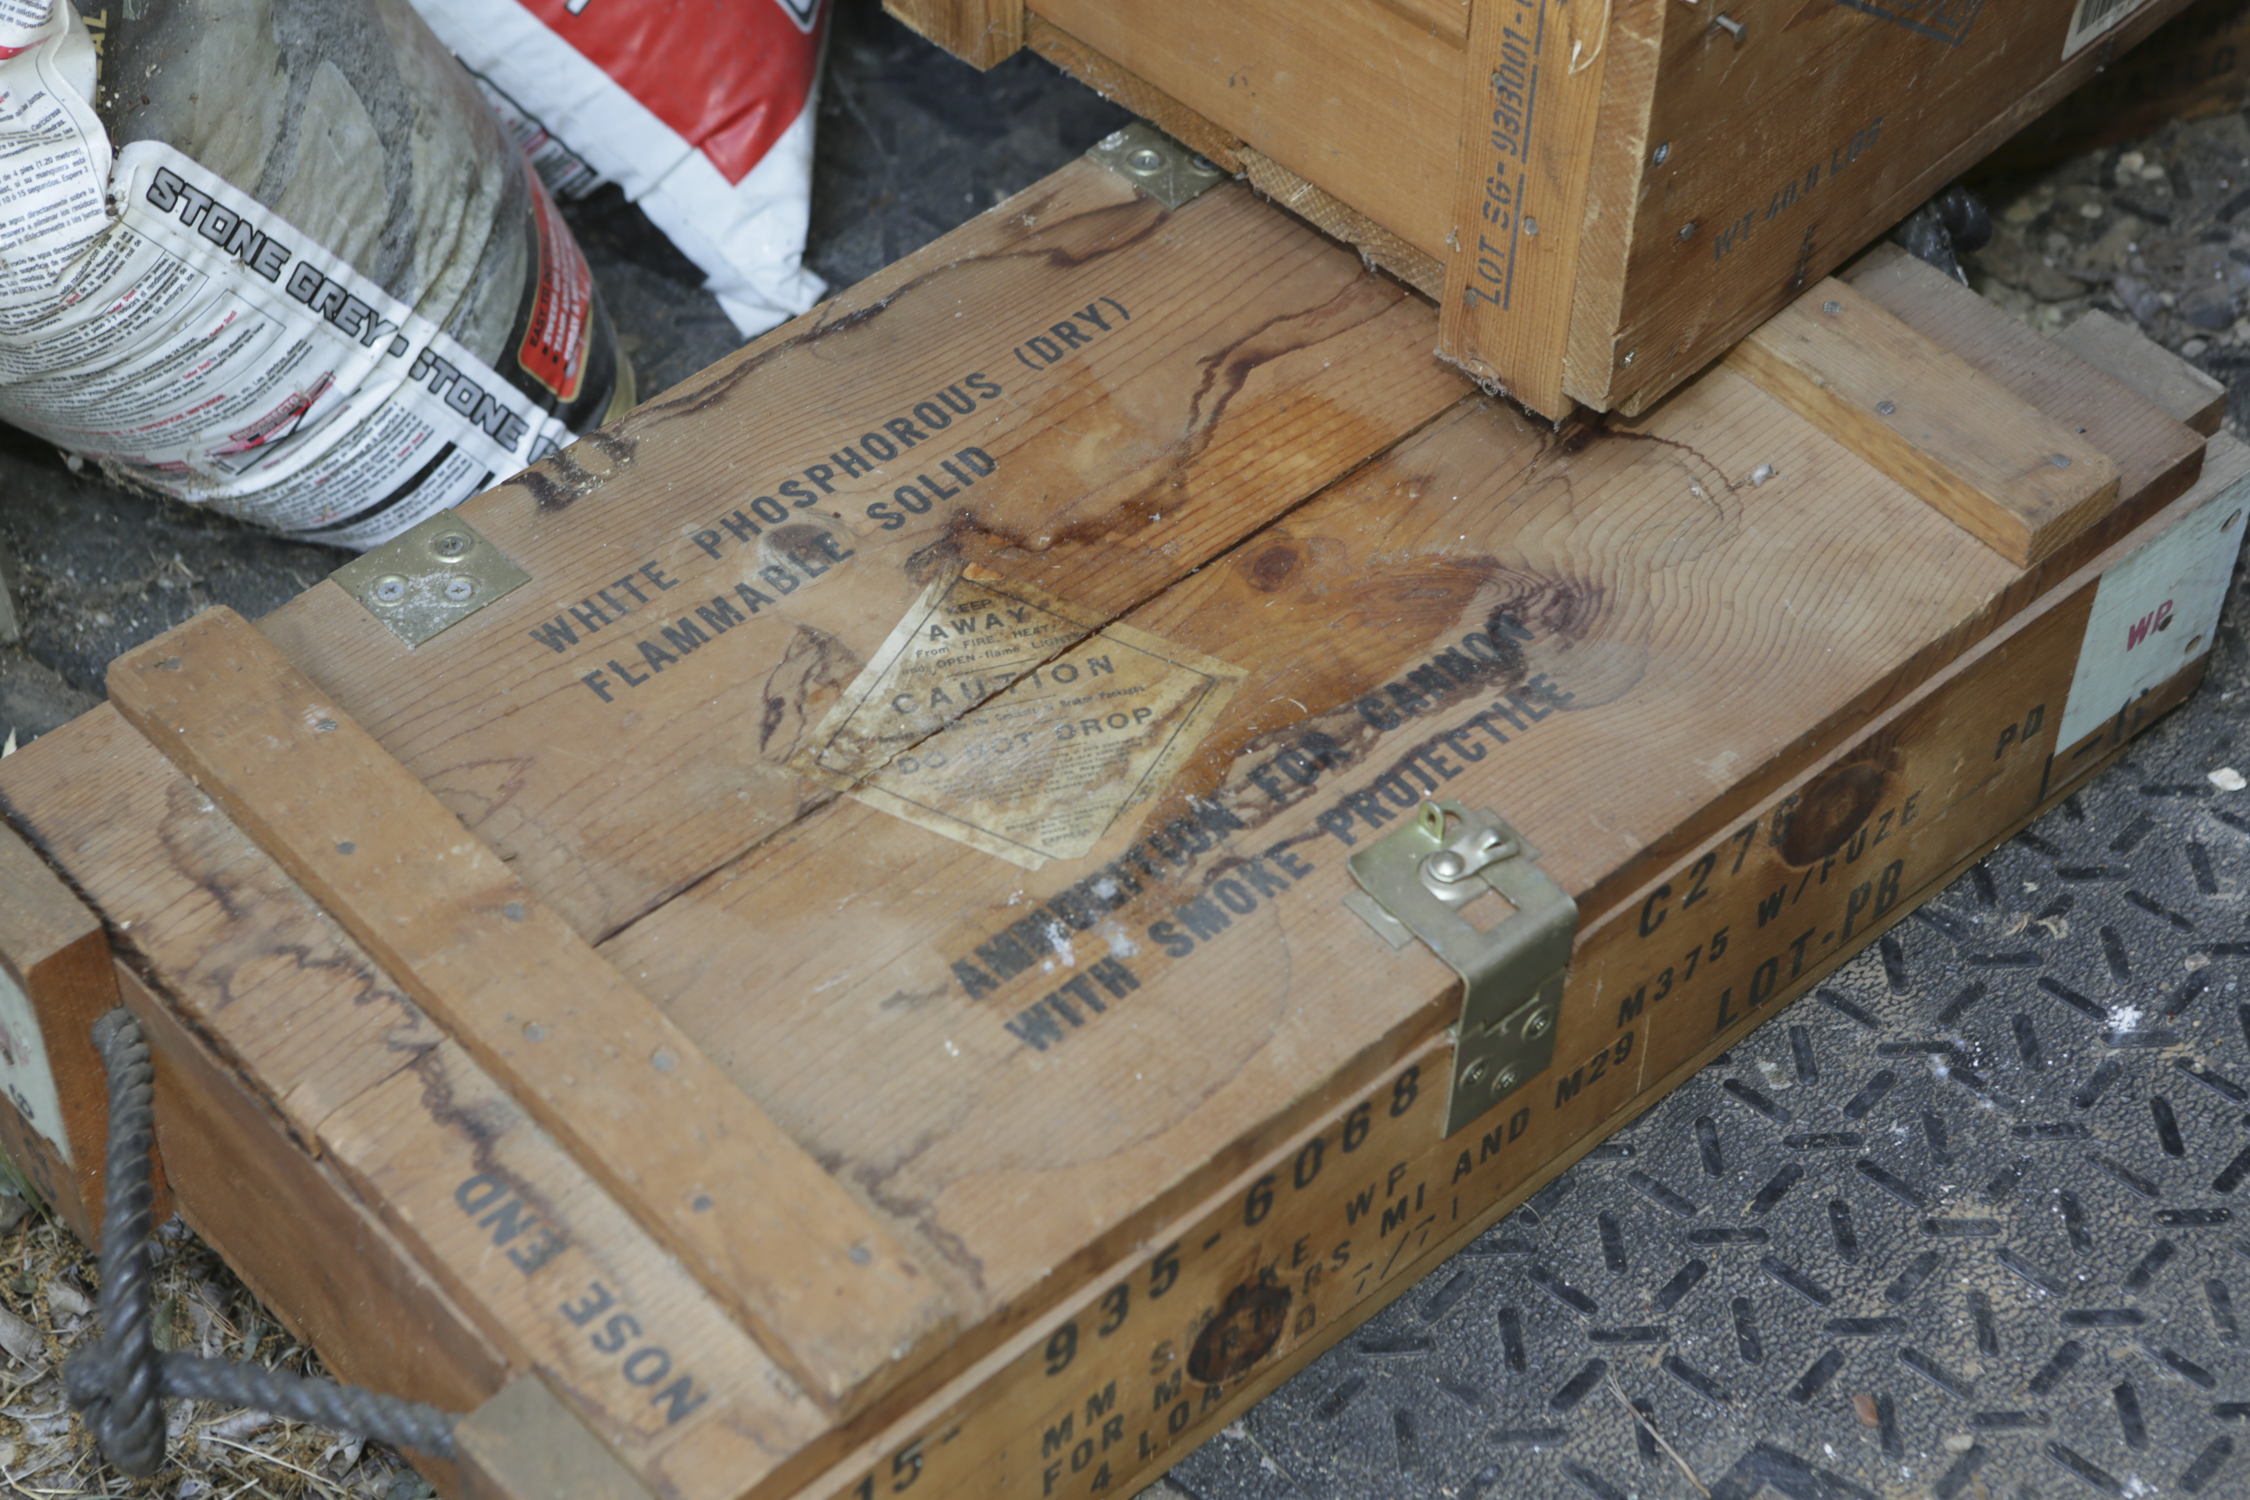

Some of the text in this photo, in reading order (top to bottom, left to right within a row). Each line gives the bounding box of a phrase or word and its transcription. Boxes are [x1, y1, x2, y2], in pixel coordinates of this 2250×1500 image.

[17, 189, 27, 198] 15
[61, 168, 84, 182] Espere
[19, 164, 34, 175] pies
[35, 163, 70, 180] manguera
[1714, 208, 1757, 261] WT
[1829, 116, 1885, 177] LBS
[8, 214, 26, 227] agua
[27, 197, 69, 220] directamente
[69, 190, 88, 202] sobre
[1474, 234, 1504, 306] LOT
[146, 165, 292, 285] STONE
[284, 259, 398, 359] GREY
[409, 347, 533, 455] STONE
[529, 309, 548, 348] EASY
[528, 295, 1132, 655] WHITE PHOSPHOROUS (DRY)
[580, 444, 1000, 705] FLAMMABLE SOLID
[946, 599, 993, 616] KEEP
[916, 645, 950, 659] From
[929, 606, 1027, 642] AWAY
[2126, 599, 2174, 652] WP
[891, 654, 1116, 716] CAUTION
[902, 664, 926, 676] and
[1059, 696, 1094, 710] Broken
[896, 749, 948, 776] DO
[966, 730, 1034, 758] NOT
[1055, 706, 1154, 742] DROP
[950, 799, 1244, 1002] AMMUNITION
[1245, 730, 1351, 803] FOR
[1357, 610, 1537, 733] CANNON
[1004, 671, 1576, 1053] WITH SMOKE PROJECTILE
[1041, 1379, 1118, 1461] MM
[1616, 925, 1730, 1030] M375
[1758, 785, 1925, 930] W/FUZE
[1042, 1413, 1125, 1497] FOR
[1152, 1239, 1352, 1414] MORTARS
[1451, 1105, 1531, 1186] AND
[1554, 1031, 1635, 1111] M29
[455, 1172, 709, 1427] NOSE END
[1090, 1461, 1113, 1496] 4
[1137, 1302, 1318, 1463] LOADD
